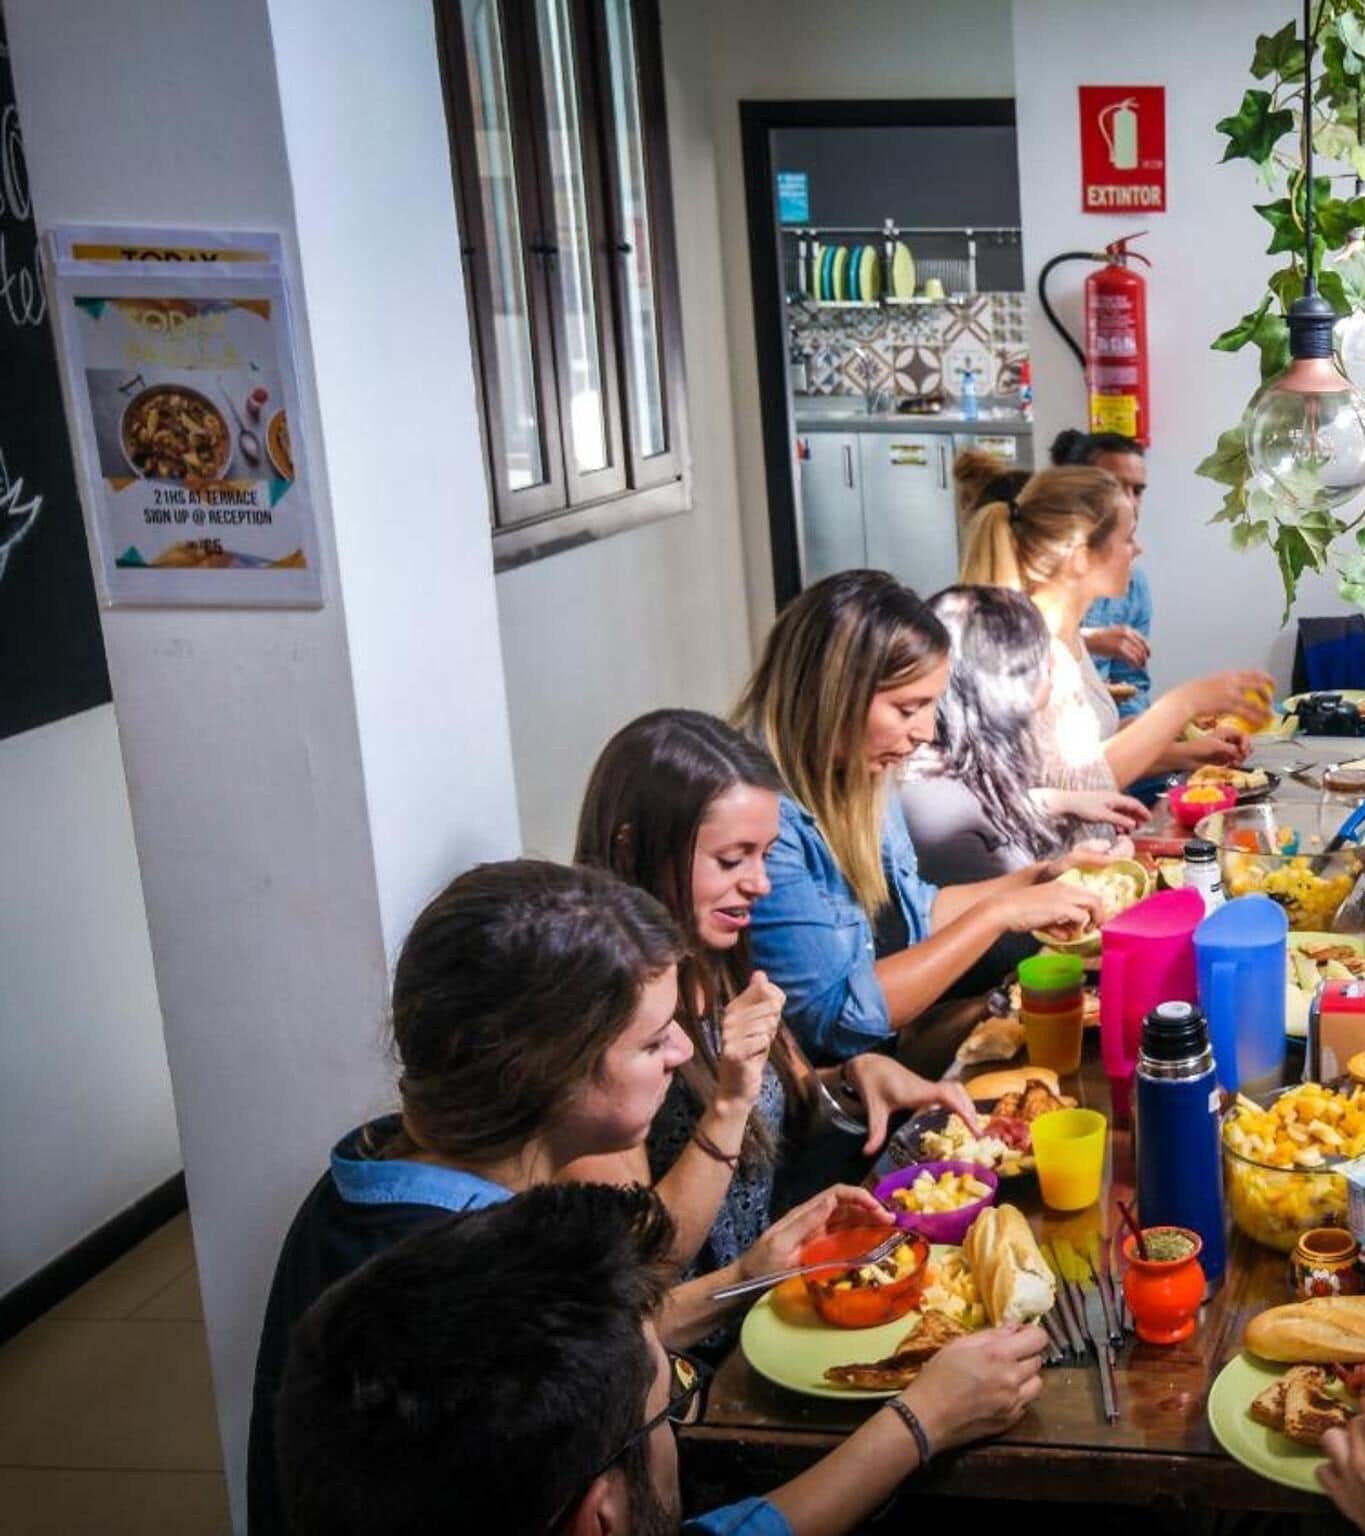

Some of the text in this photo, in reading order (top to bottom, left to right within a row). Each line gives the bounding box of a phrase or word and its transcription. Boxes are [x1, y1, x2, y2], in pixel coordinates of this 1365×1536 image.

[1087, 185, 1161, 206] EXTINTOR
[121, 248, 218, 263] TODY
[189, 490, 202, 505] AT
[207, 489, 258, 506] TERRACE
[144, 508, 171, 525] SIGN
[174, 509, 190, 524] UP
[209, 509, 272, 525] RECEPTION
